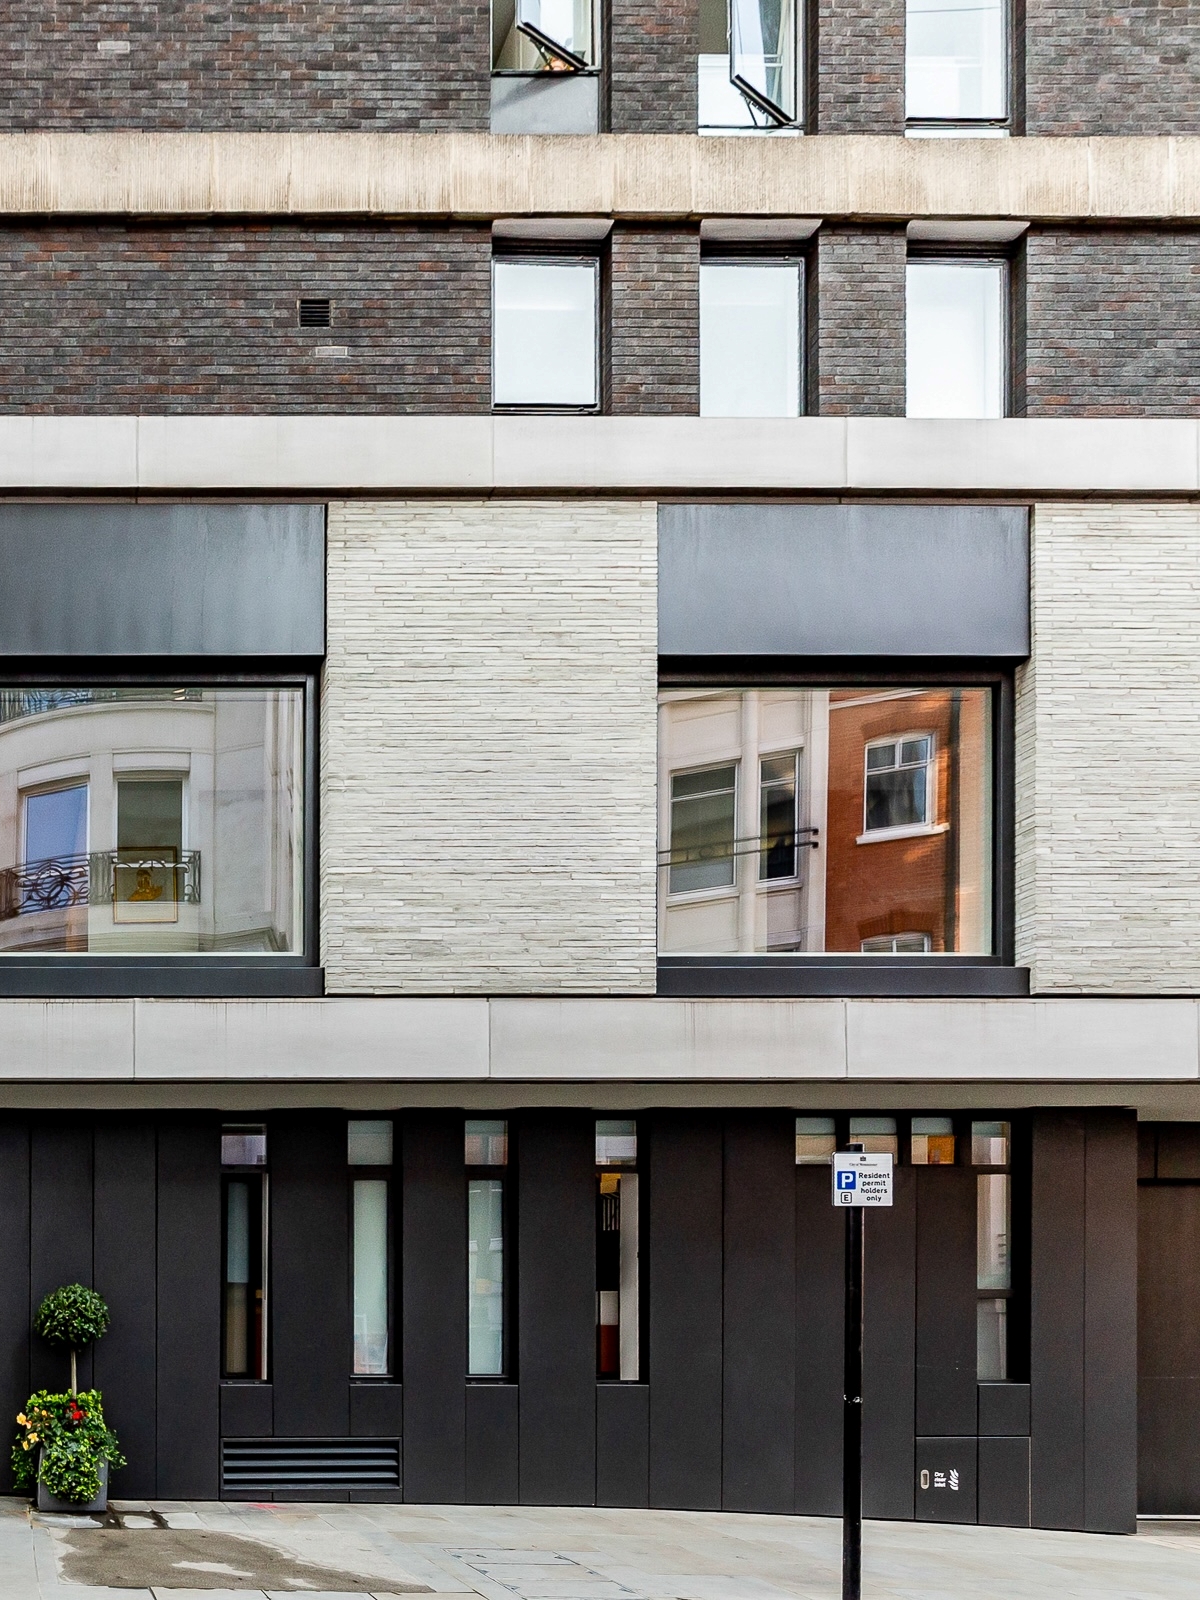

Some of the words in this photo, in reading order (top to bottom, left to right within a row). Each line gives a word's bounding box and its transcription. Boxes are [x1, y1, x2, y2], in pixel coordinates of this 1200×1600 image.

[841, 1173, 853, 1188] P
[844, 1194, 849, 1202] E
[866, 1194, 882, 1202] only
